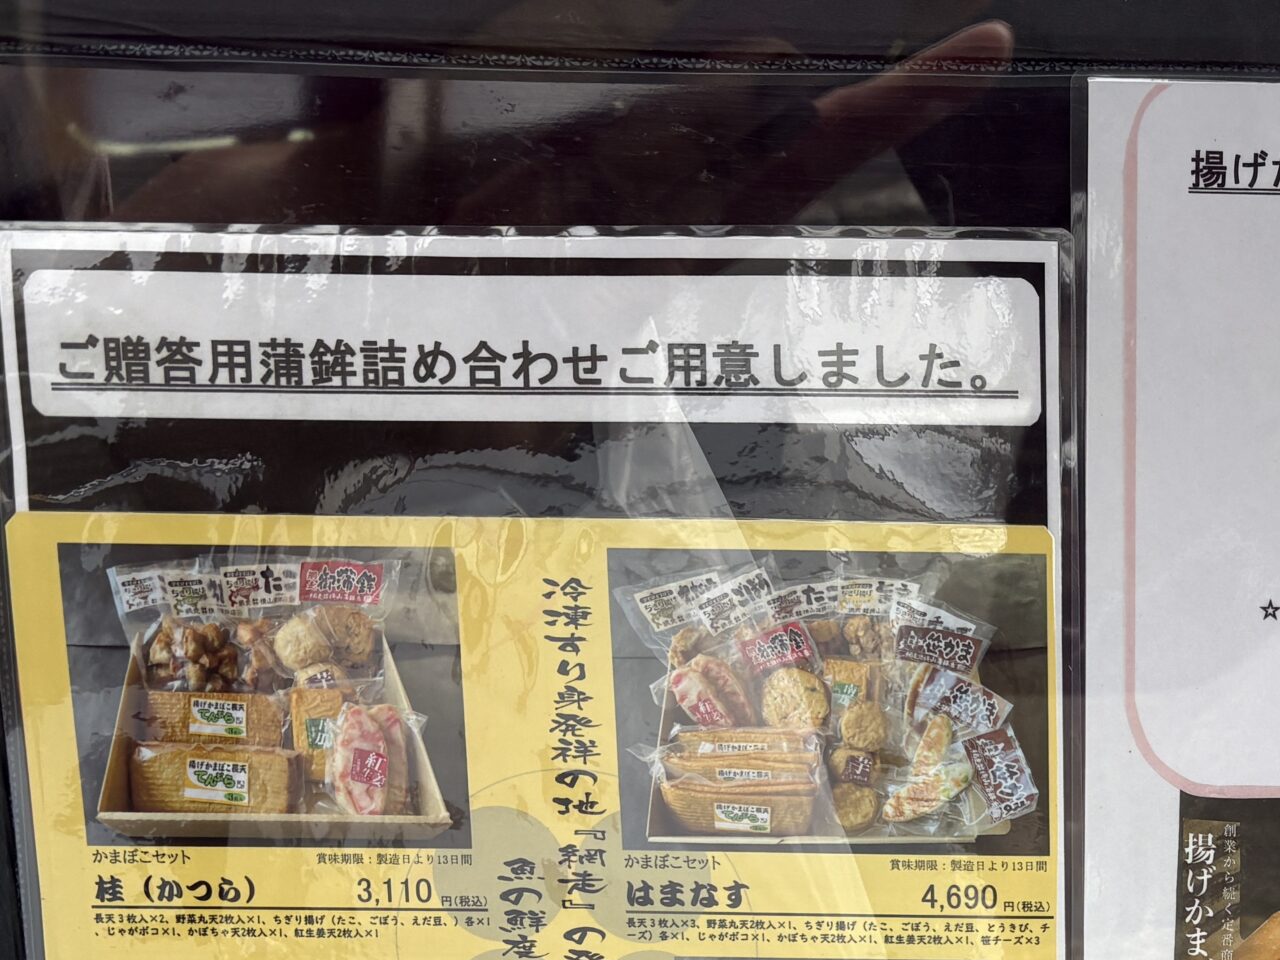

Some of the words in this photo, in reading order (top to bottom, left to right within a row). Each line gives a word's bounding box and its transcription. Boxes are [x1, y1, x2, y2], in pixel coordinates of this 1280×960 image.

[59, 334, 988, 391] ご贈答用蒲鉾詰め合わせご用意しました。
[92, 849, 191, 865] かまぼこセット
[624, 854, 721, 870] かまぼこセット
[626, 880, 750, 908] はまなす
